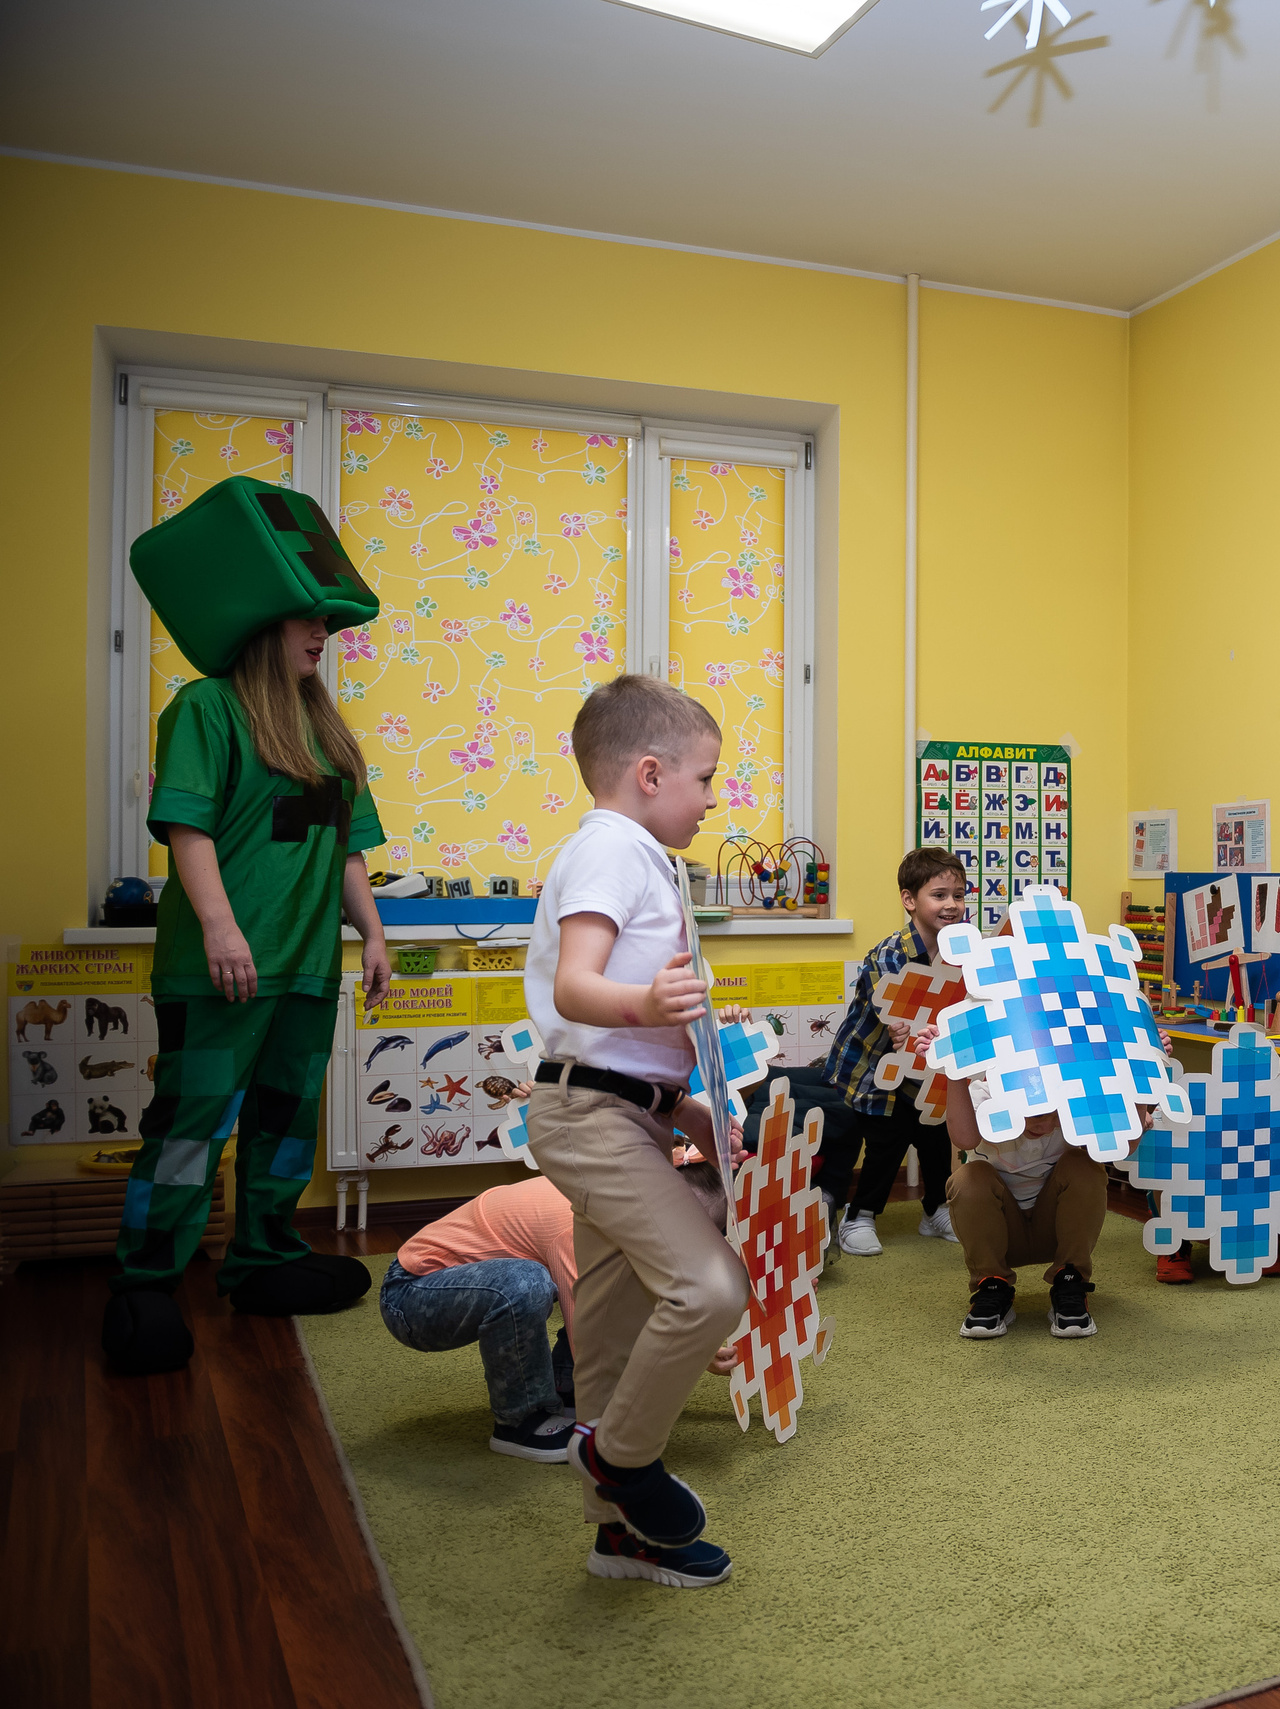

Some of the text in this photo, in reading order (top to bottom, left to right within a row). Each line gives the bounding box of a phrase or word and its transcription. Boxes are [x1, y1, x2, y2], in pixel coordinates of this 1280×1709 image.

[956, 745, 1037, 760] АЛФАВИТ
[923, 764, 1060, 786] А Б В Г Д
[924, 789, 1061, 812] Е Ё Ж З И
[924, 818, 1061, 840] Й К Л М Н
[955, 850, 1061, 868] П Р С Т
[985, 879, 1002, 896] Х
[984, 907, 1001, 924] Ъ
[30, 949, 120, 961] ЖИВОТНЫЕ
[16, 962, 134, 975] ЖАРКИХ СТРАН
[714, 976, 748, 987] МЫЕ
[386, 984, 453, 999] ИР МОРЕЙ
[380, 998, 453, 1010] И ОКЕАНОВ
